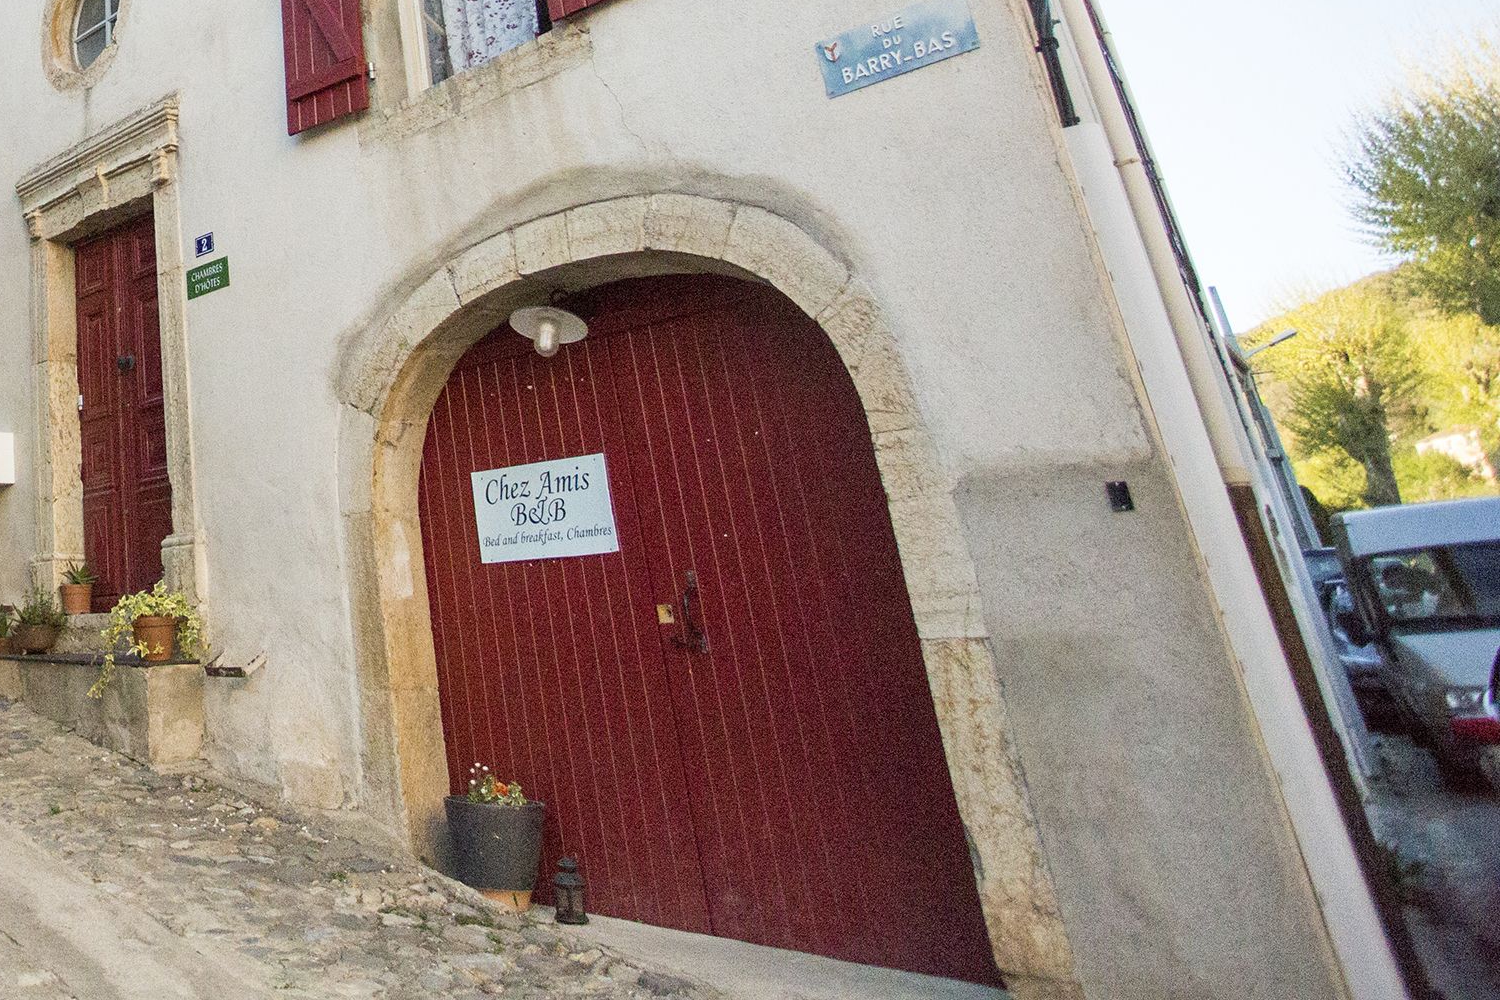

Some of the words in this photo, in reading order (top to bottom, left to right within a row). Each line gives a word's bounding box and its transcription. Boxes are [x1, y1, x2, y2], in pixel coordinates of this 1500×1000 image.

[870, 15, 904, 38] RUE
[883, 36, 903, 49] DU
[841, 30, 956, 85] BARRY-BAS
[201, 238, 208, 252] 2
[191, 262, 223, 282] CHAMBRES
[485, 474, 531, 505] Chez
[535, 466, 590, 499] Amis
[510, 496, 567, 526] B&B
[483, 533, 500, 548] Bed
[502, 531, 520, 546] and
[520, 528, 564, 546] breakfast,
[566, 523, 613, 541] Chambres
